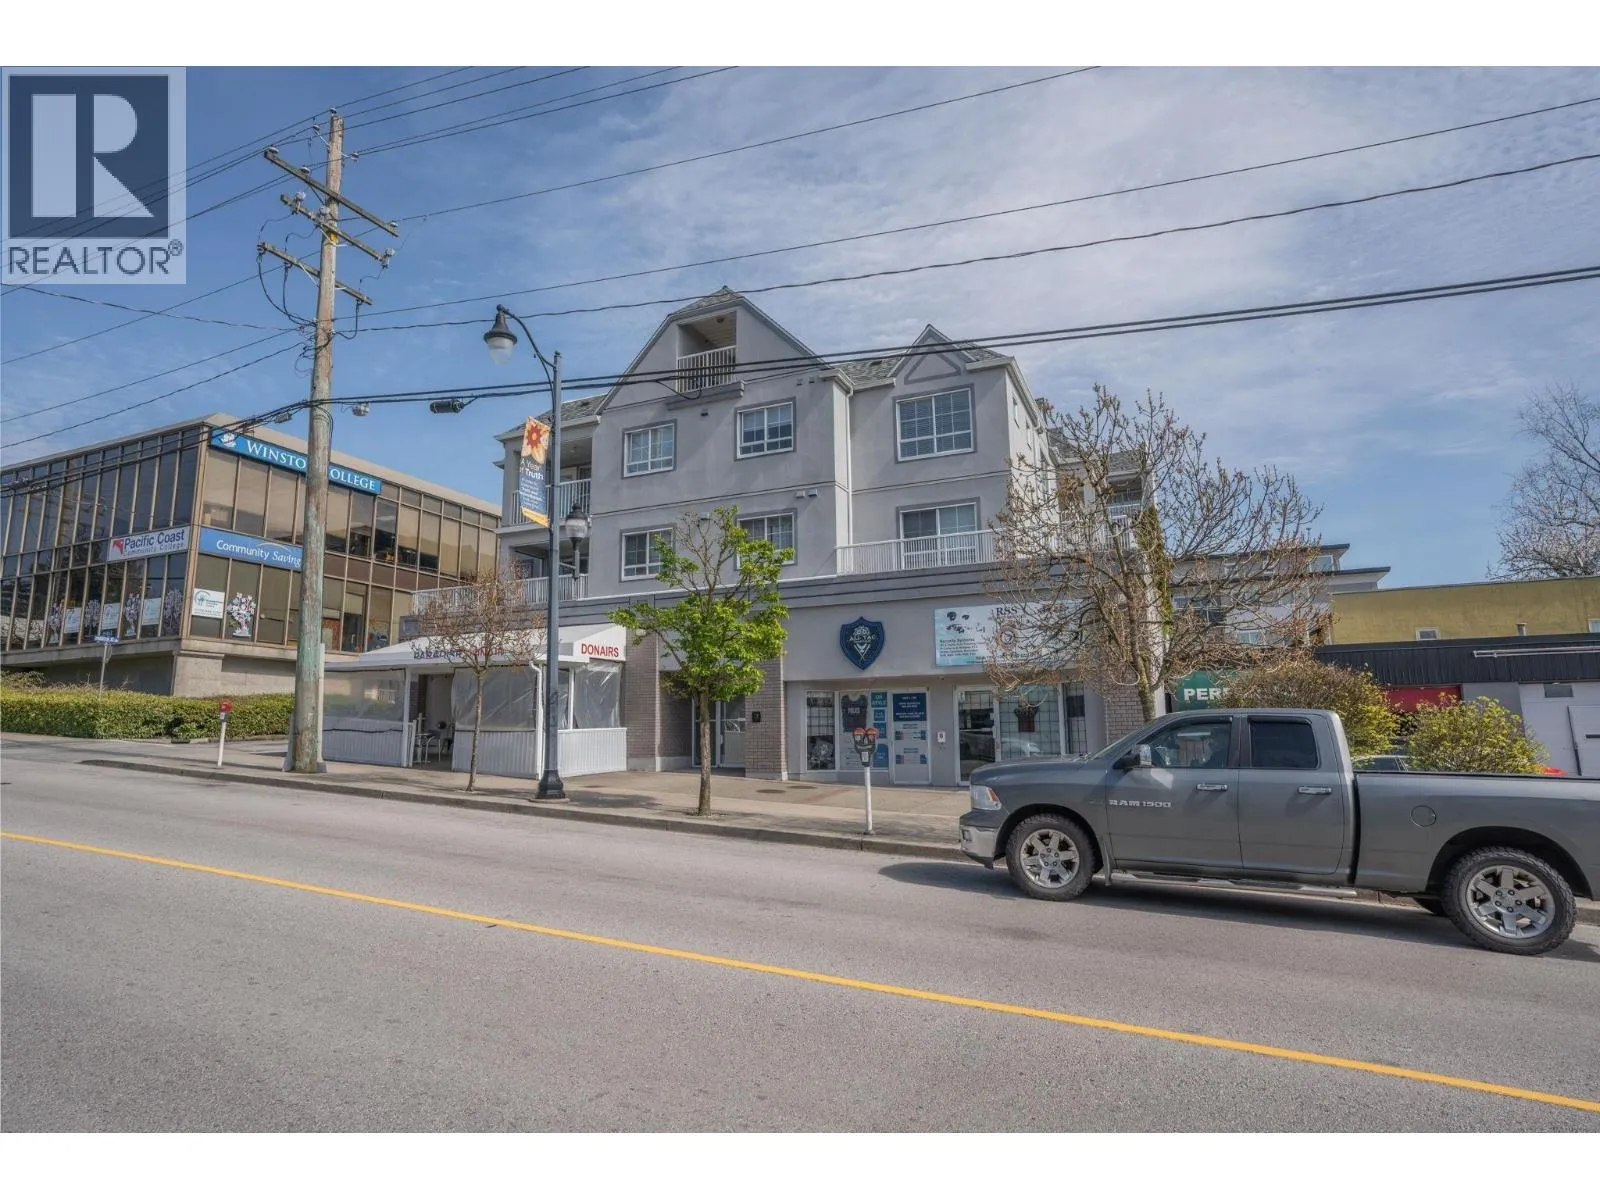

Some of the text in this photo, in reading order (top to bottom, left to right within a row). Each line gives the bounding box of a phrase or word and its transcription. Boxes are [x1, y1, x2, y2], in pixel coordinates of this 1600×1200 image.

[245, 439, 376, 491] WINSTO OLLEGE
[525, 468, 544, 480] Truth
[124, 529, 185, 550] Pacific Coast
[216, 539, 302, 568] Community Saving
[581, 643, 619, 657] DONAIRS
[1109, 799, 1140, 807] RAM
